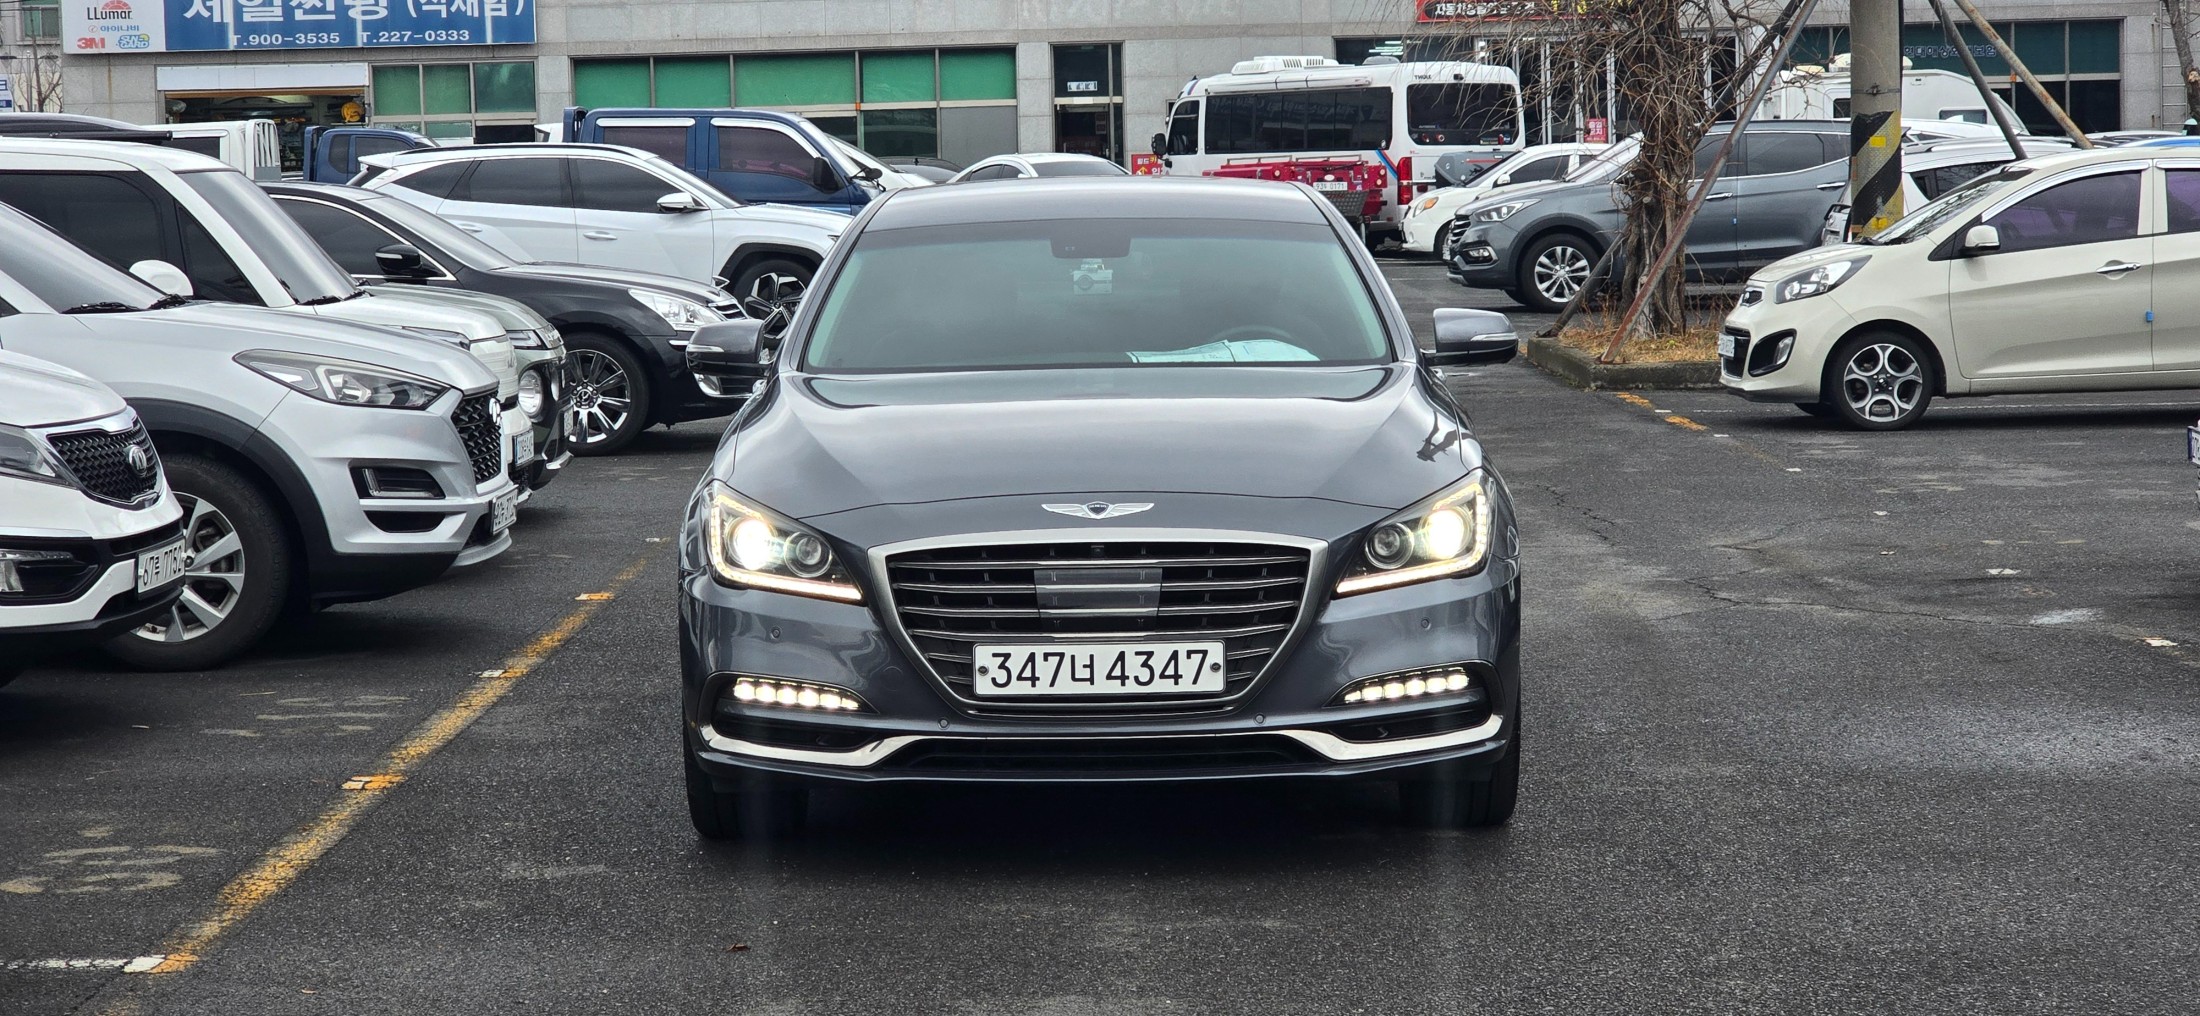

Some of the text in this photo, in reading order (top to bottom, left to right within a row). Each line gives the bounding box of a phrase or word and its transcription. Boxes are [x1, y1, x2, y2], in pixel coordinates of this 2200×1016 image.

[87, 7, 132, 20] LLumar
[77, 37, 106, 49] 3M
[232, 30, 470, 46] T.900-3535 T.227-0333
[1904, 45, 1997, 58] 현대해상화보험
[990, 649, 1209, 688] 347너 4347
